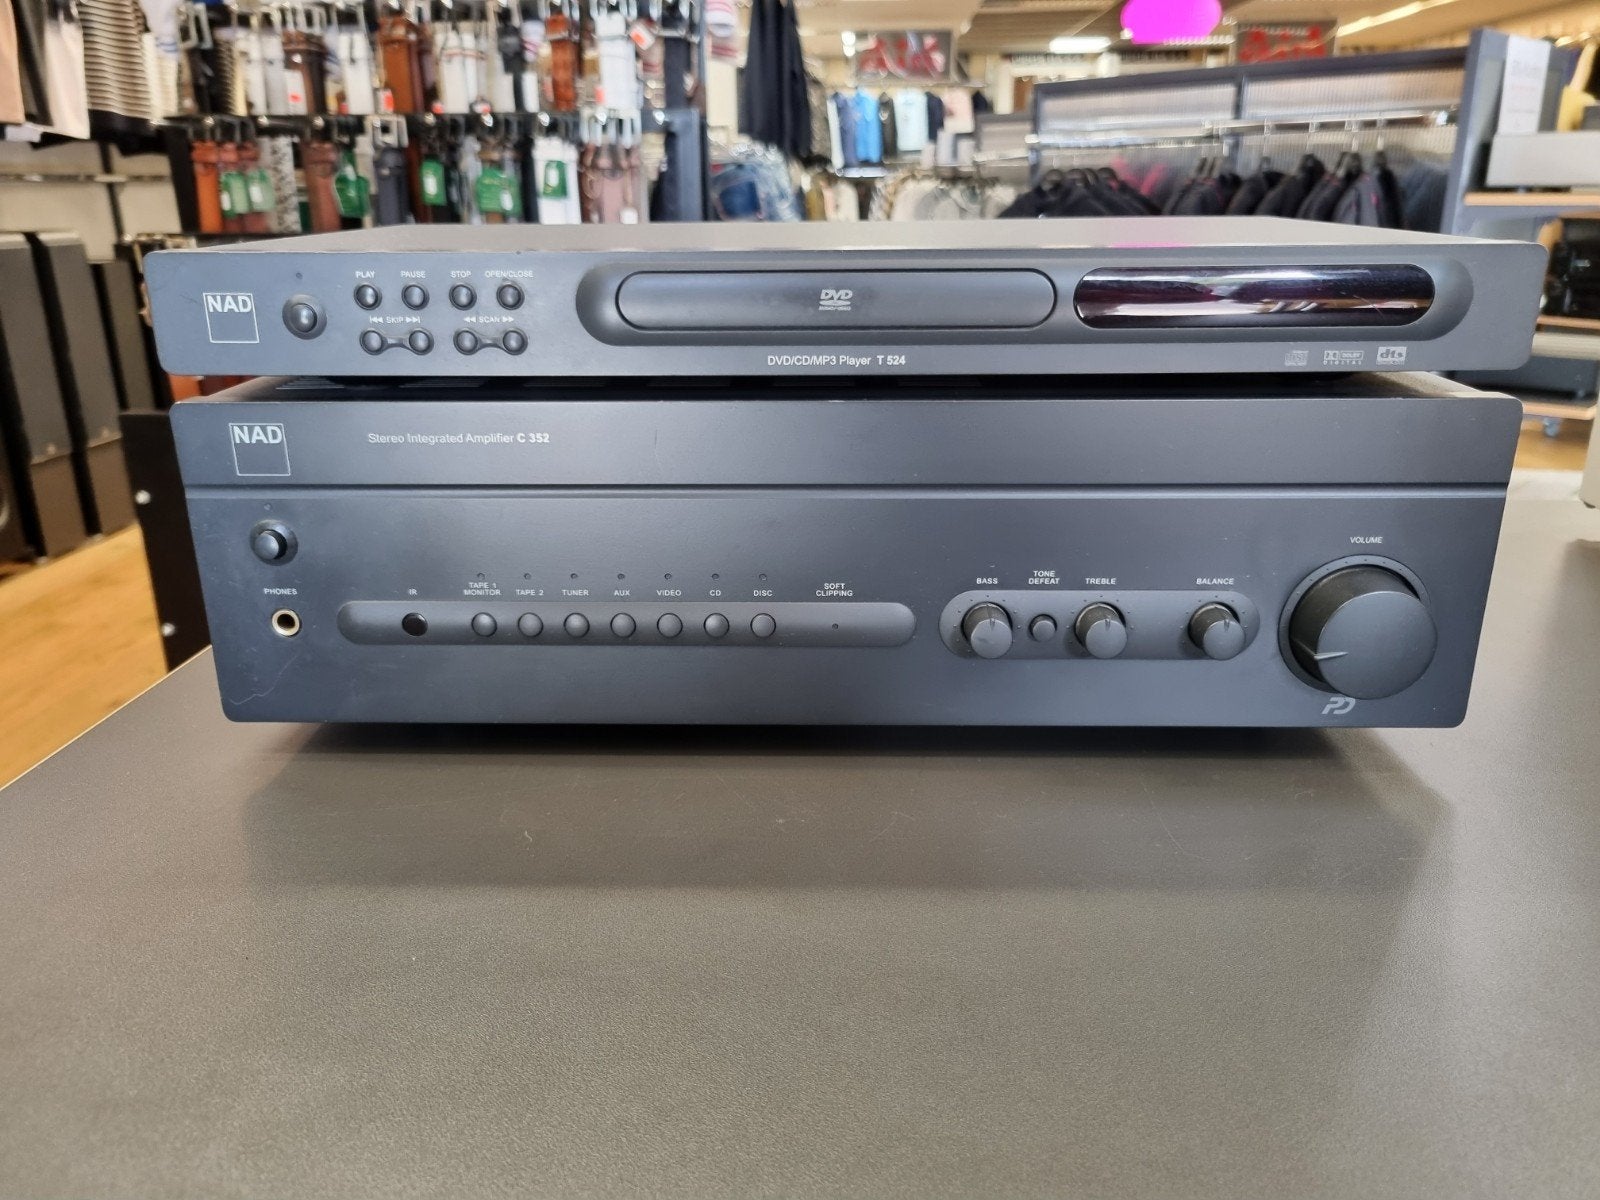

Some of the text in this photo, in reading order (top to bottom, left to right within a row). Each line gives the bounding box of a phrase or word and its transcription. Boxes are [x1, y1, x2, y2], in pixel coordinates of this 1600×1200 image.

[355, 270, 376, 279] PLAY
[400, 270, 427, 279] PAUSE
[450, 270, 472, 279] STOP
[484, 269, 534, 279] OPEN/CLOSE
[820, 289, 853, 301] DVD
[206, 294, 253, 314] NAD
[386, 316, 404, 324] SKIP
[478, 315, 501, 324] SCAN
[767, 355, 906, 368] DVD/CD/MP3 Player T 524
[234, 425, 283, 444] NAD
[368, 432, 550, 446] Stereo Integrated Amplifier C 352
[1349, 536, 1383, 544] VOLUME
[468, 581, 490, 589] TAPE
[976, 577, 998, 585] BASS
[1028, 577, 1060, 585] DEFEAT
[1085, 577, 1117, 585] TREBLE
[1196, 577, 1235, 585] BALANCE
[823, 582, 846, 590] SOFT
[263, 588, 298, 596] PHONES
[408, 588, 418, 596] IR
[463, 588, 502, 596] MONITOR
[515, 588, 537, 597] TAPE
[561, 588, 590, 597] TUNER
[613, 588, 631, 597] AUX
[656, 588, 682, 597] VIDEO
[709, 588, 722, 597] CD
[753, 588, 773, 597] DISC
[815, 589, 854, 597] CLIPPING
